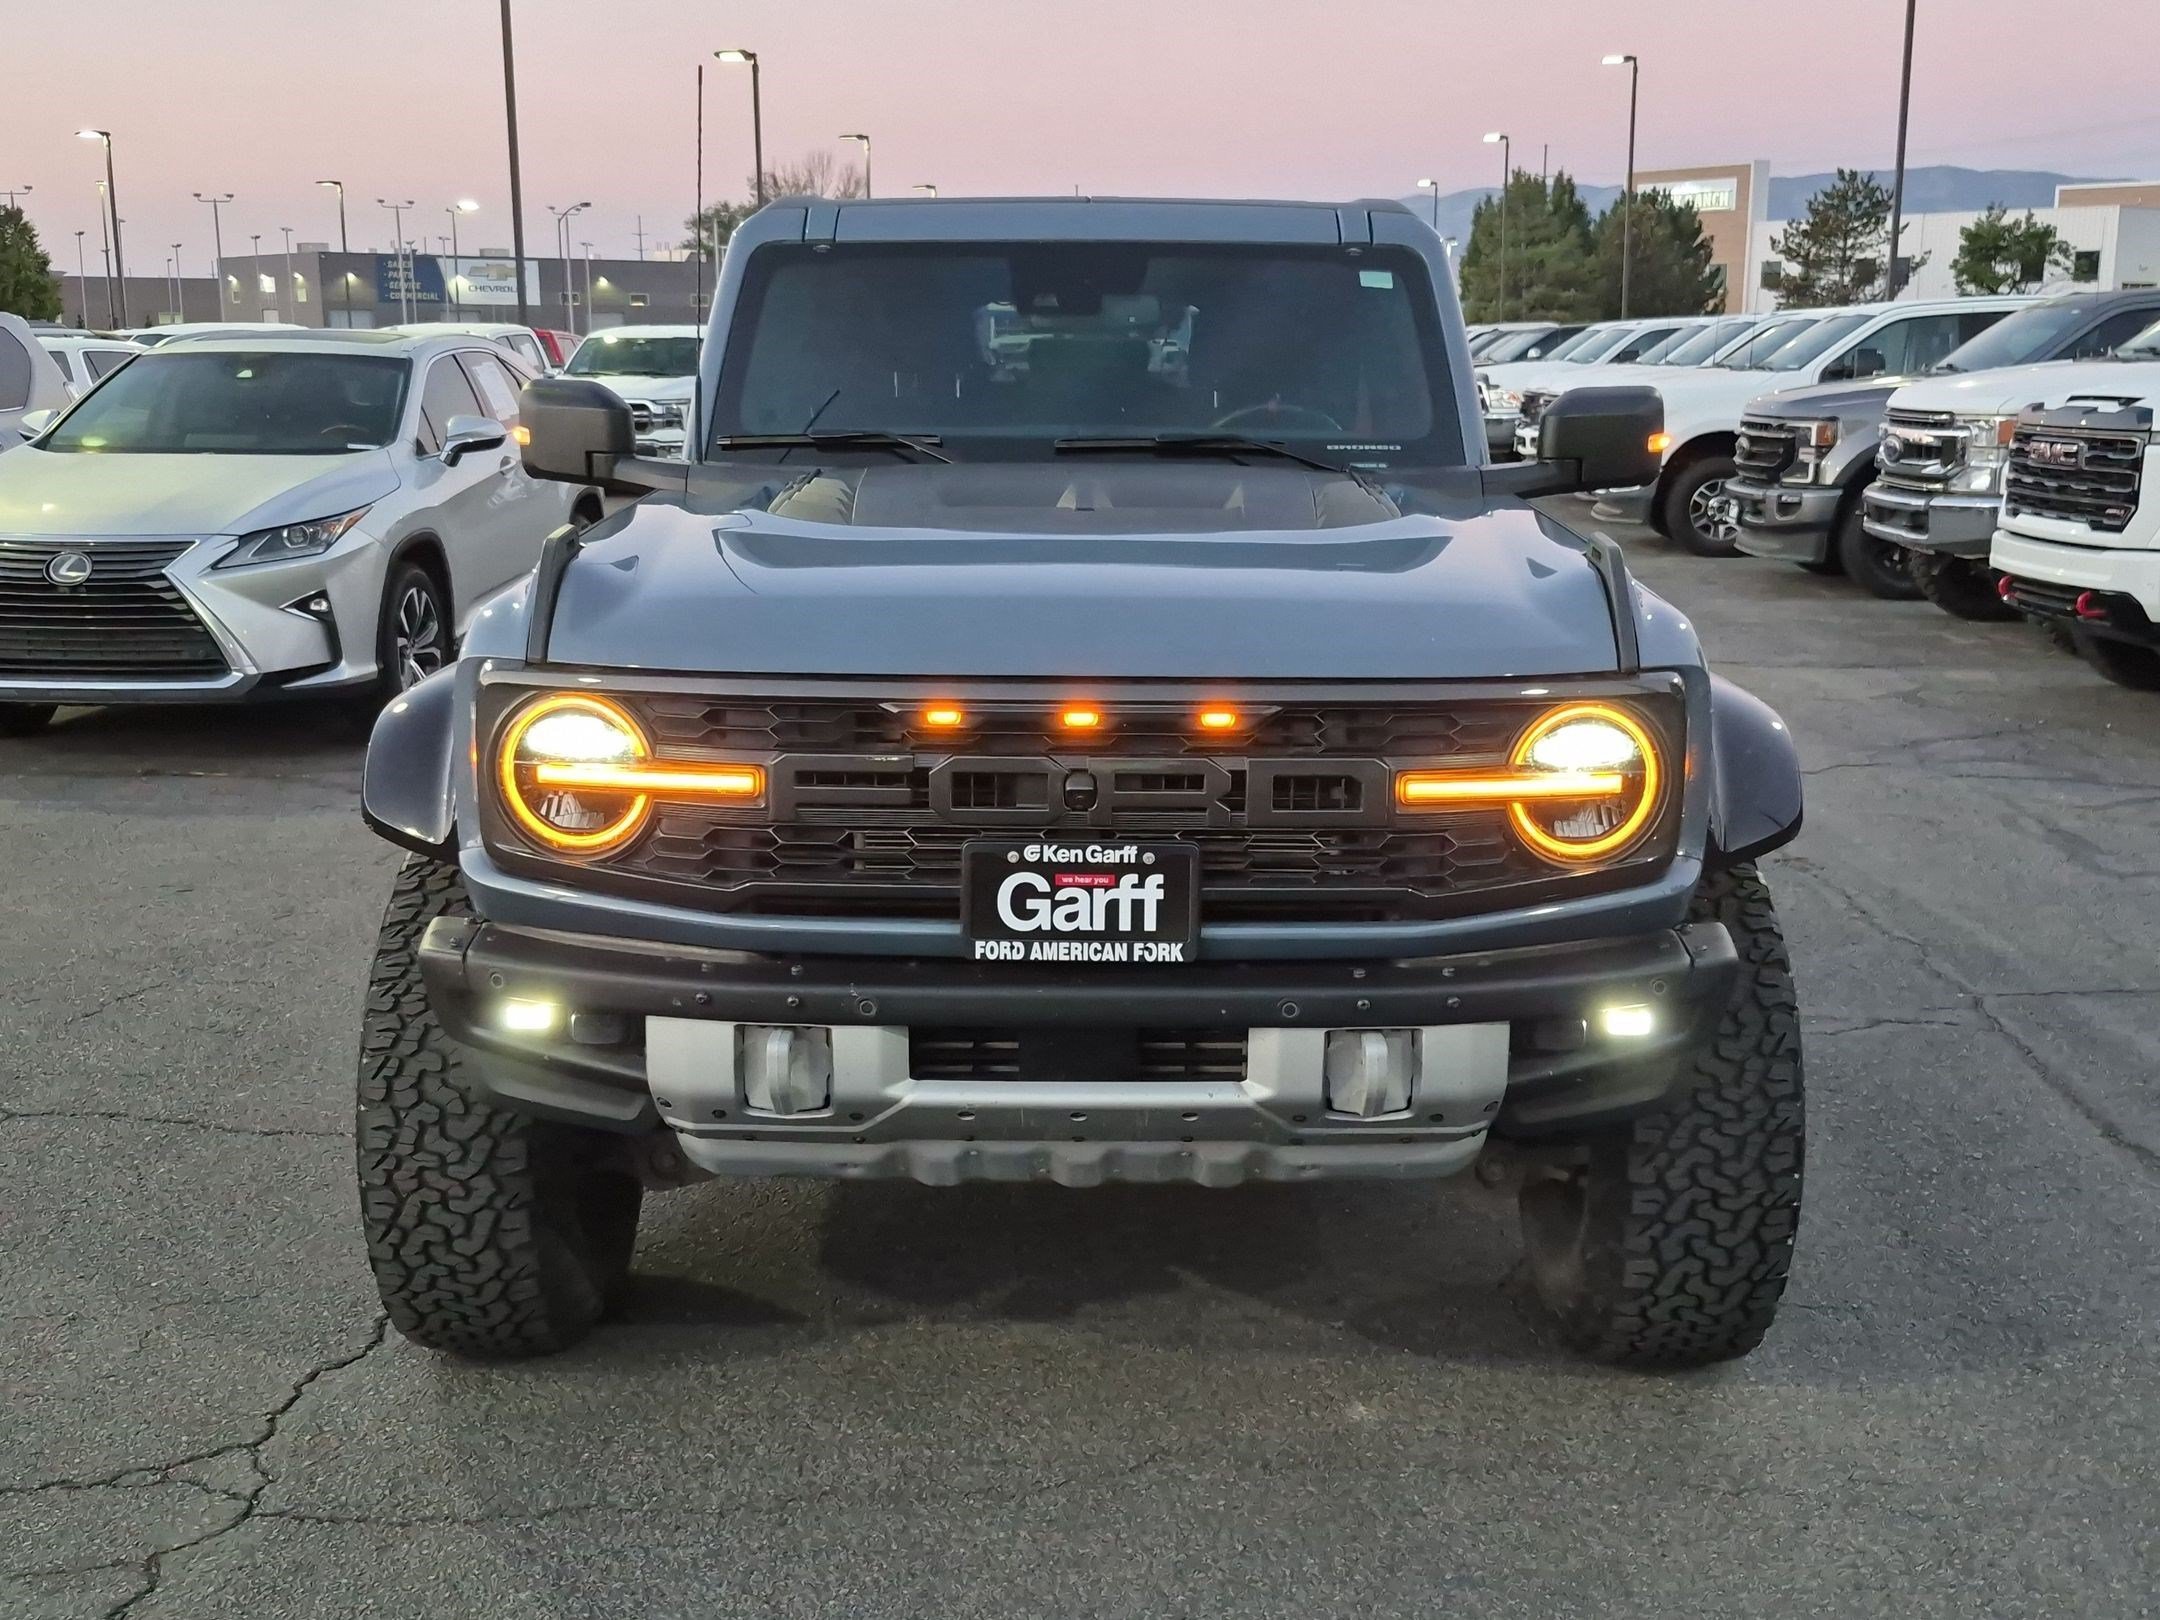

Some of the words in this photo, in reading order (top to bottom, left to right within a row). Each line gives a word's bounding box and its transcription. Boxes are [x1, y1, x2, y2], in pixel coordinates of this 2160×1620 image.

[468, 285, 518, 293] CHEVROL
[390, 292, 440, 301] COMRCIAL
[1042, 845, 1083, 863] Ken
[1085, 845, 1138, 863] Garff
[1074, 875, 1093, 884] hear
[1094, 876, 1109, 885] you
[997, 871, 1165, 932] Garff
[975, 940, 1025, 960] FORD
[1030, 941, 1128, 961] AMERICAN
[1133, 942, 1184, 962] FORK
